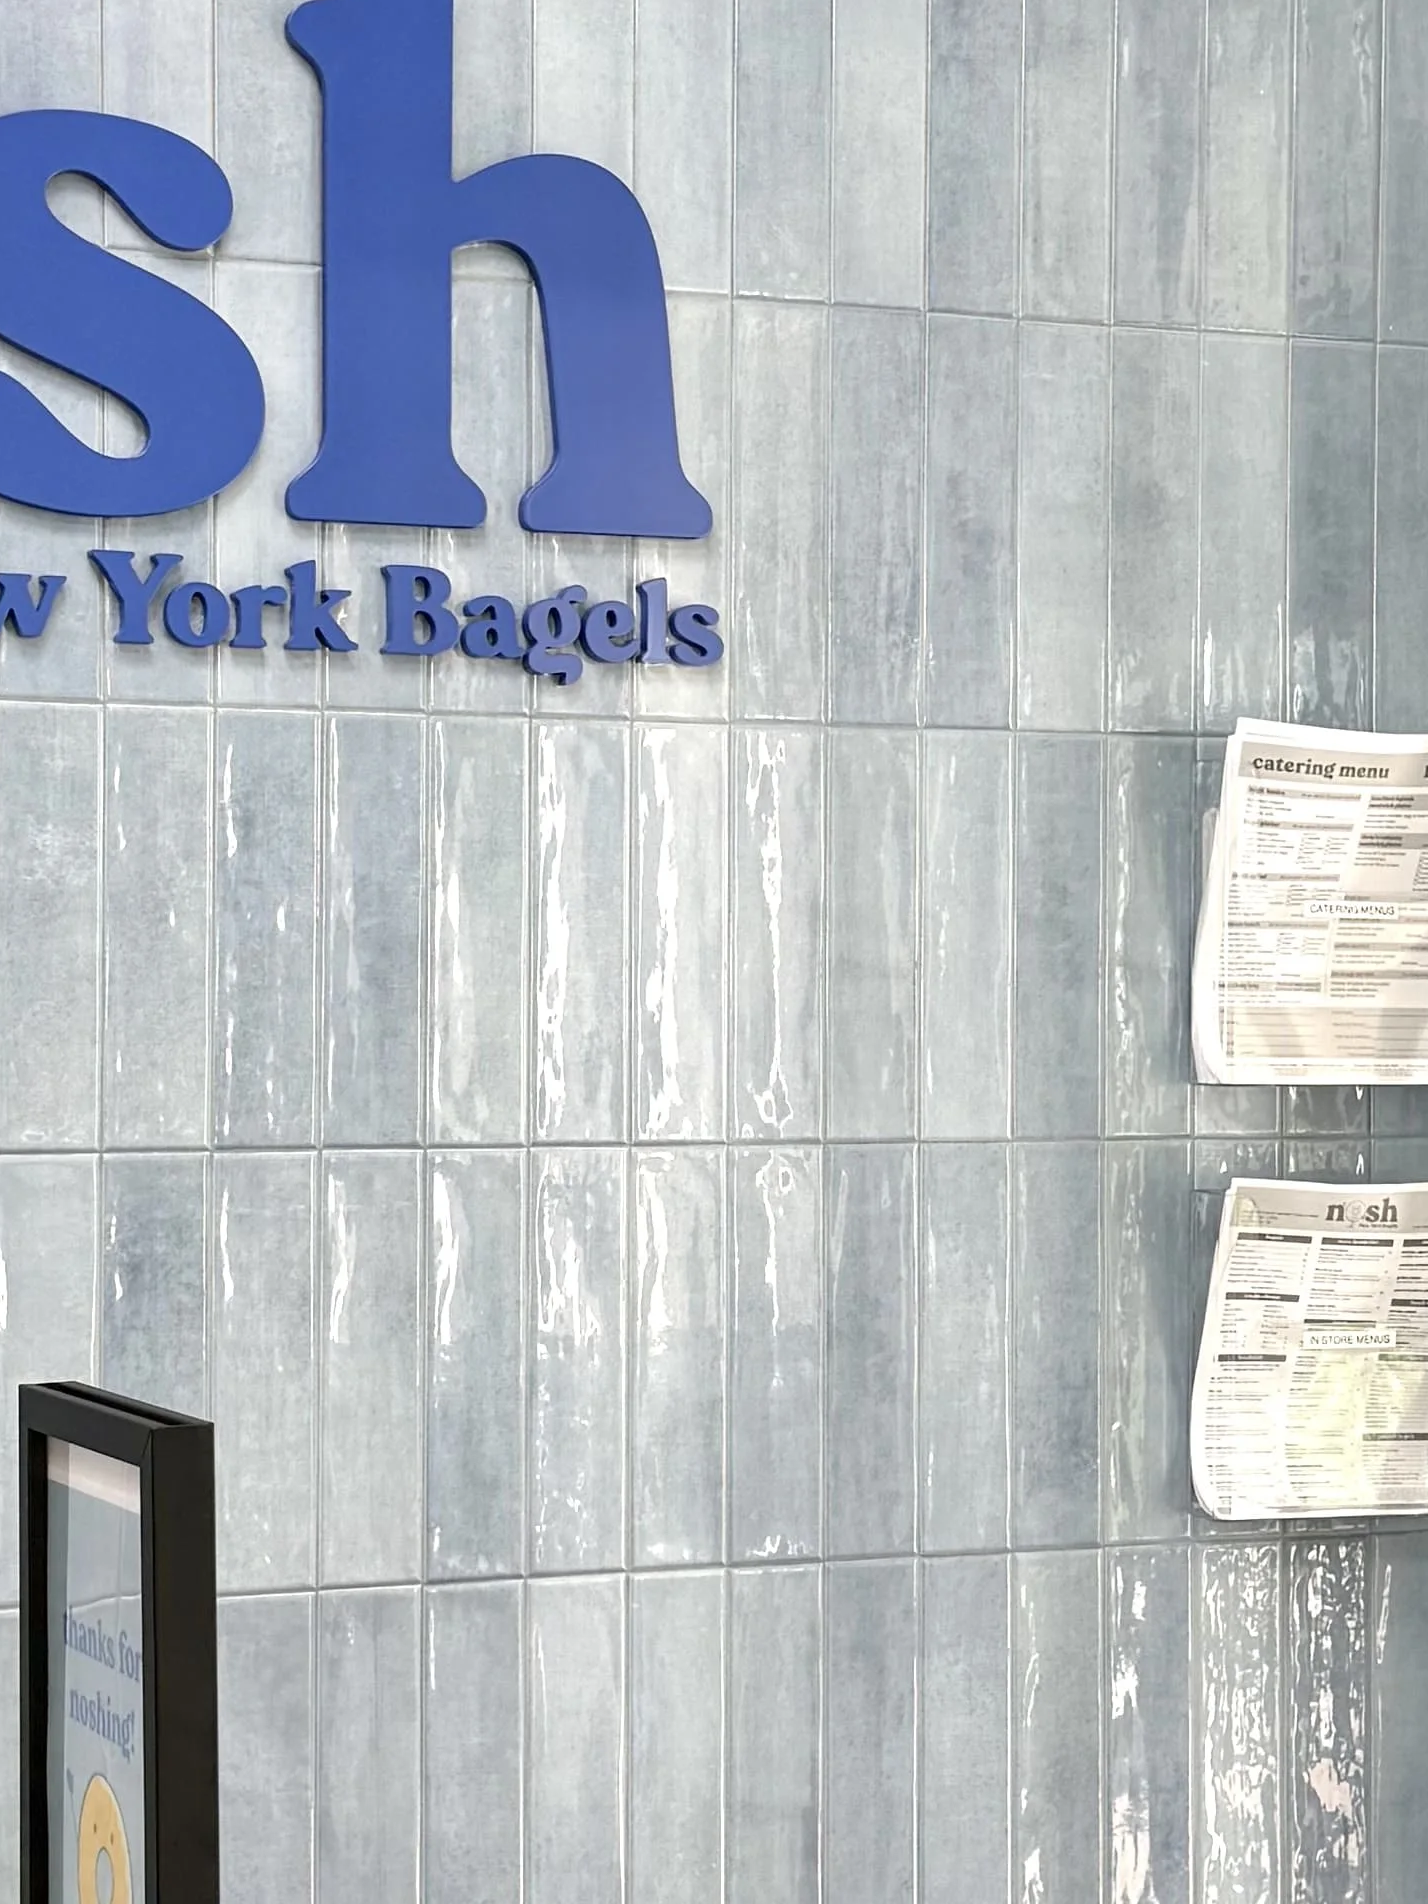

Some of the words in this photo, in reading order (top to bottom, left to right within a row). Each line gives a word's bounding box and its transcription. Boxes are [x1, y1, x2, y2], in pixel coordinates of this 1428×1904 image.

[88, 549, 359, 654] York
[380, 563, 726, 686] Bagels
[1252, 756, 1337, 779] catering
[1338, 765, 1390, 779] menu
[1321, 1335, 1353, 1345] STORE
[1356, 1334, 1391, 1345] MENUS
[63, 1606, 115, 1669] thanks
[118, 1630, 141, 1683] for
[70, 1689, 136, 1764] noshing!
